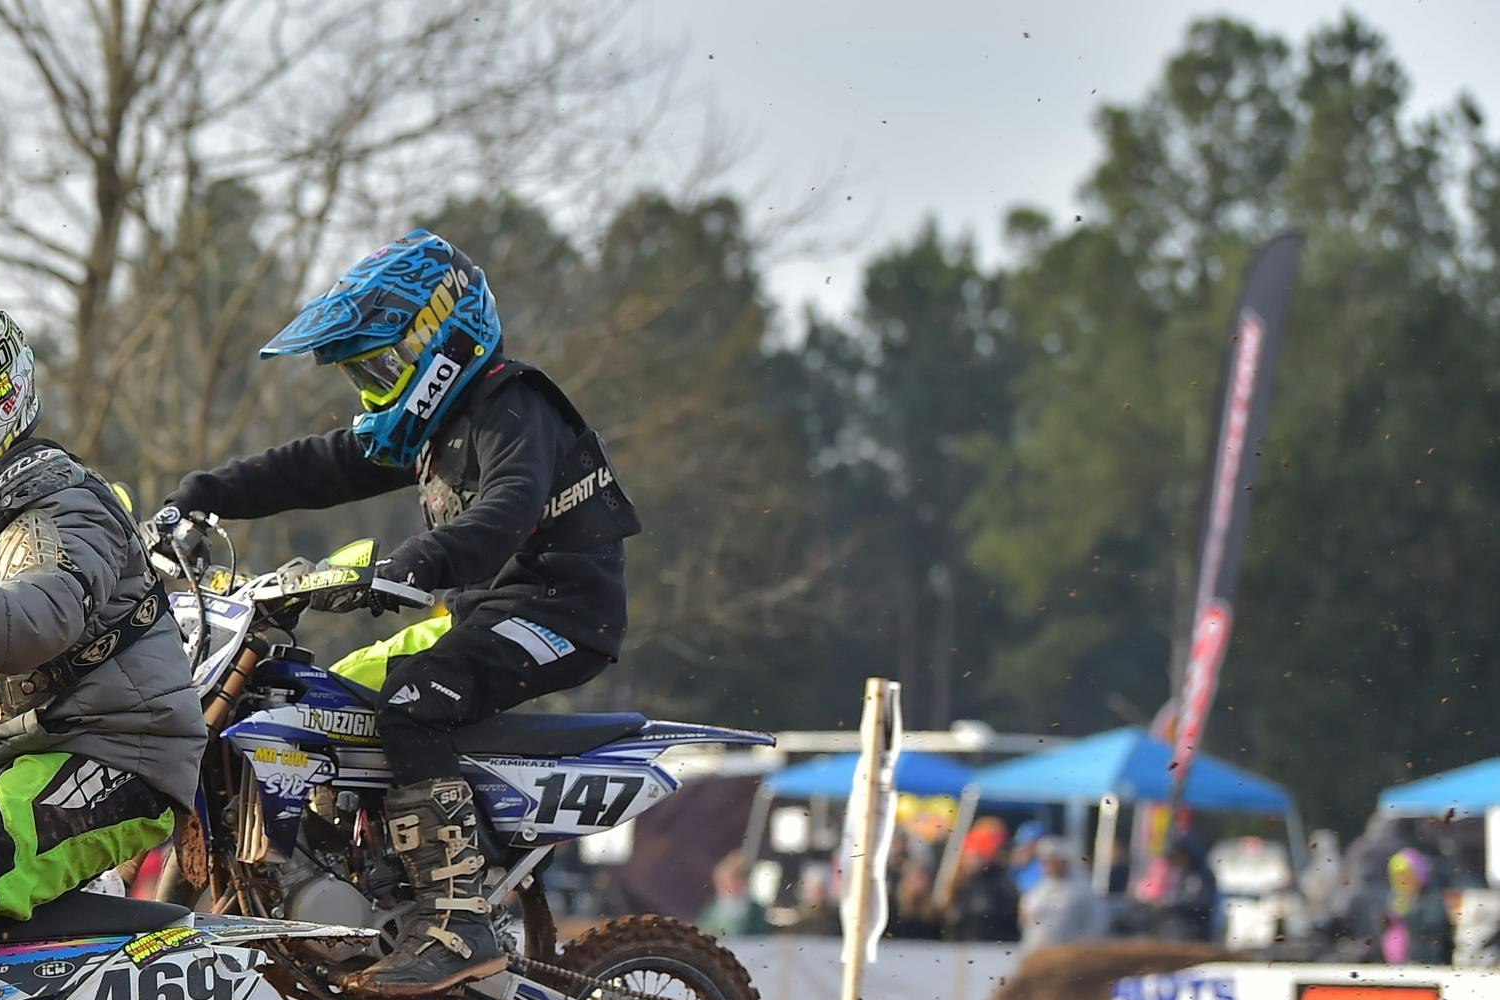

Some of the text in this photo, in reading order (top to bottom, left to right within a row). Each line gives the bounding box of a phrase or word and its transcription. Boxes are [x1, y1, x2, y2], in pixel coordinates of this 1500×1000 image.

[404, 268, 468, 352] 100%
[417, 363, 454, 415] 440
[551, 471, 597, 518] LEATT
[430, 680, 462, 701] THOR
[489, 759, 557, 768] KAMIKAZE
[534, 771, 645, 827] 147
